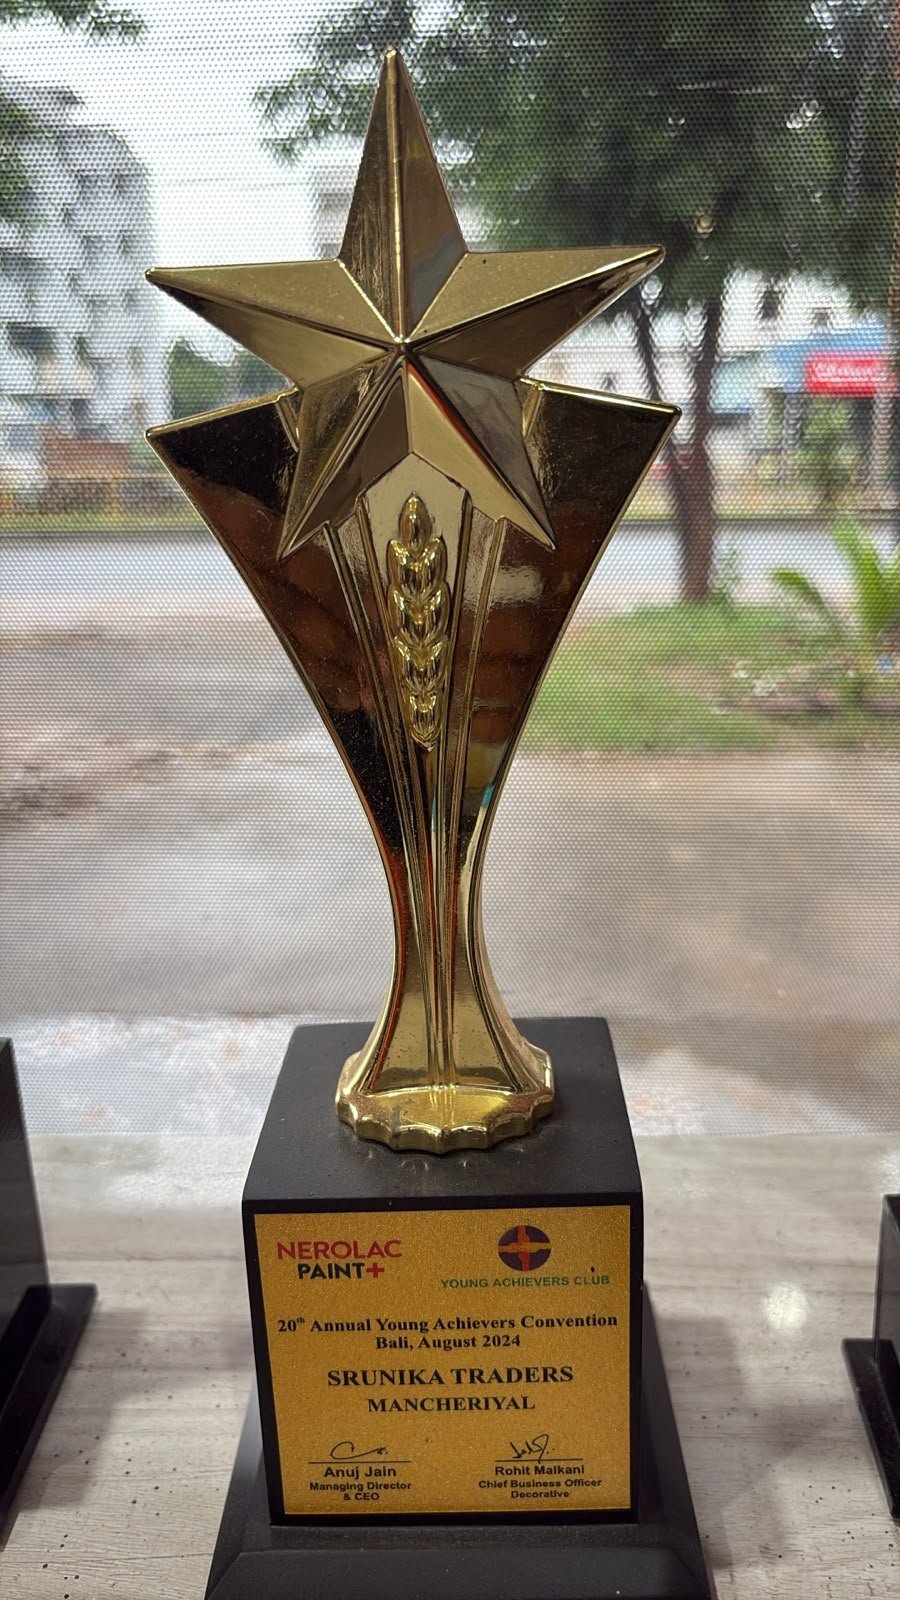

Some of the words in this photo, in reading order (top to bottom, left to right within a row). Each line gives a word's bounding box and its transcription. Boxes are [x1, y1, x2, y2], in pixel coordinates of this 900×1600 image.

[277, 1239, 402, 1260] NEROLAC
[441, 1278, 488, 1289] YOUNG
[493, 1276, 569, 1288] ACHIEVERS
[574, 1275, 610, 1286] CLUB
[277, 1316, 306, 1333] 20th
[310, 1319, 371, 1332] Annual
[375, 1317, 429, 1334] Young
[433, 1315, 515, 1330] Achievers
[520, 1314, 618, 1329] Convention
[375, 1335, 414, 1351] Bali,
[417, 1335, 477, 1351] August
[482, 1334, 521, 1348] 2024
[327, 1369, 445, 1387] SRUNIKA
[450, 1366, 574, 1384] TRADERS
[368, 1396, 536, 1413] MANCHERIYAL
[323, 1465, 360, 1480] Anuj
[364, 1465, 397, 1478] Jain
[495, 1465, 531, 1476] Rohit
[534, 1464, 585, 1476] Malkani
[309, 1481, 364, 1493] Managing
[367, 1480, 412, 1491] Director
[478, 1479, 508, 1489] Chief
[510, 1478, 562, 1488] Business
[565, 1477, 602, 1488] Officer
[343, 1493, 352, 1502] &
[354, 1492, 380, 1502] CEO
[511, 1489, 570, 1499] Decorative
